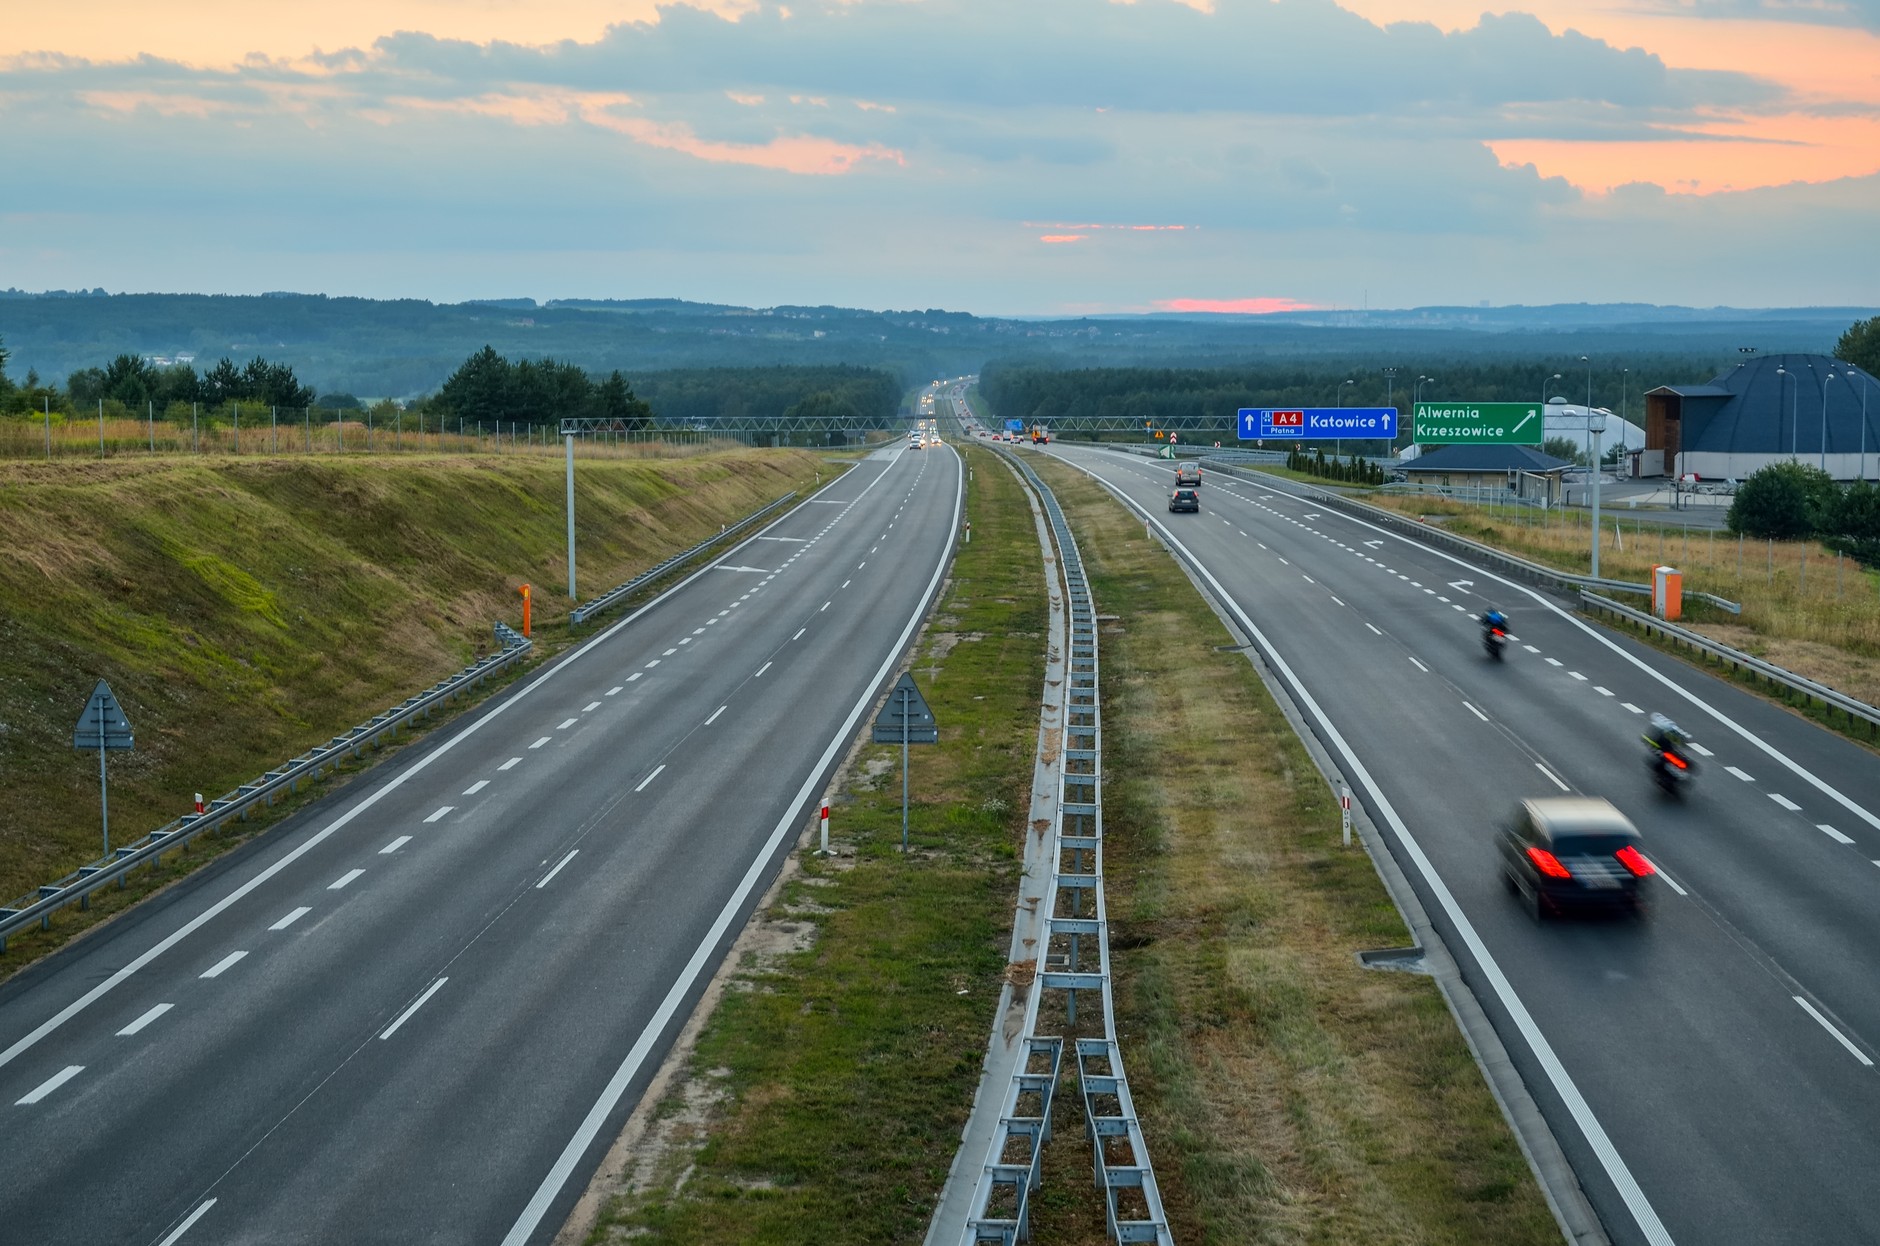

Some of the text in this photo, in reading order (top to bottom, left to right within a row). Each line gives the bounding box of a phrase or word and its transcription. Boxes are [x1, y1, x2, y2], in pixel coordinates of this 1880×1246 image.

[1417, 406, 1479, 418] Alwernia
[1310, 415, 1376, 428] Katowice
[1417, 424, 1504, 436] Krzeszowice
